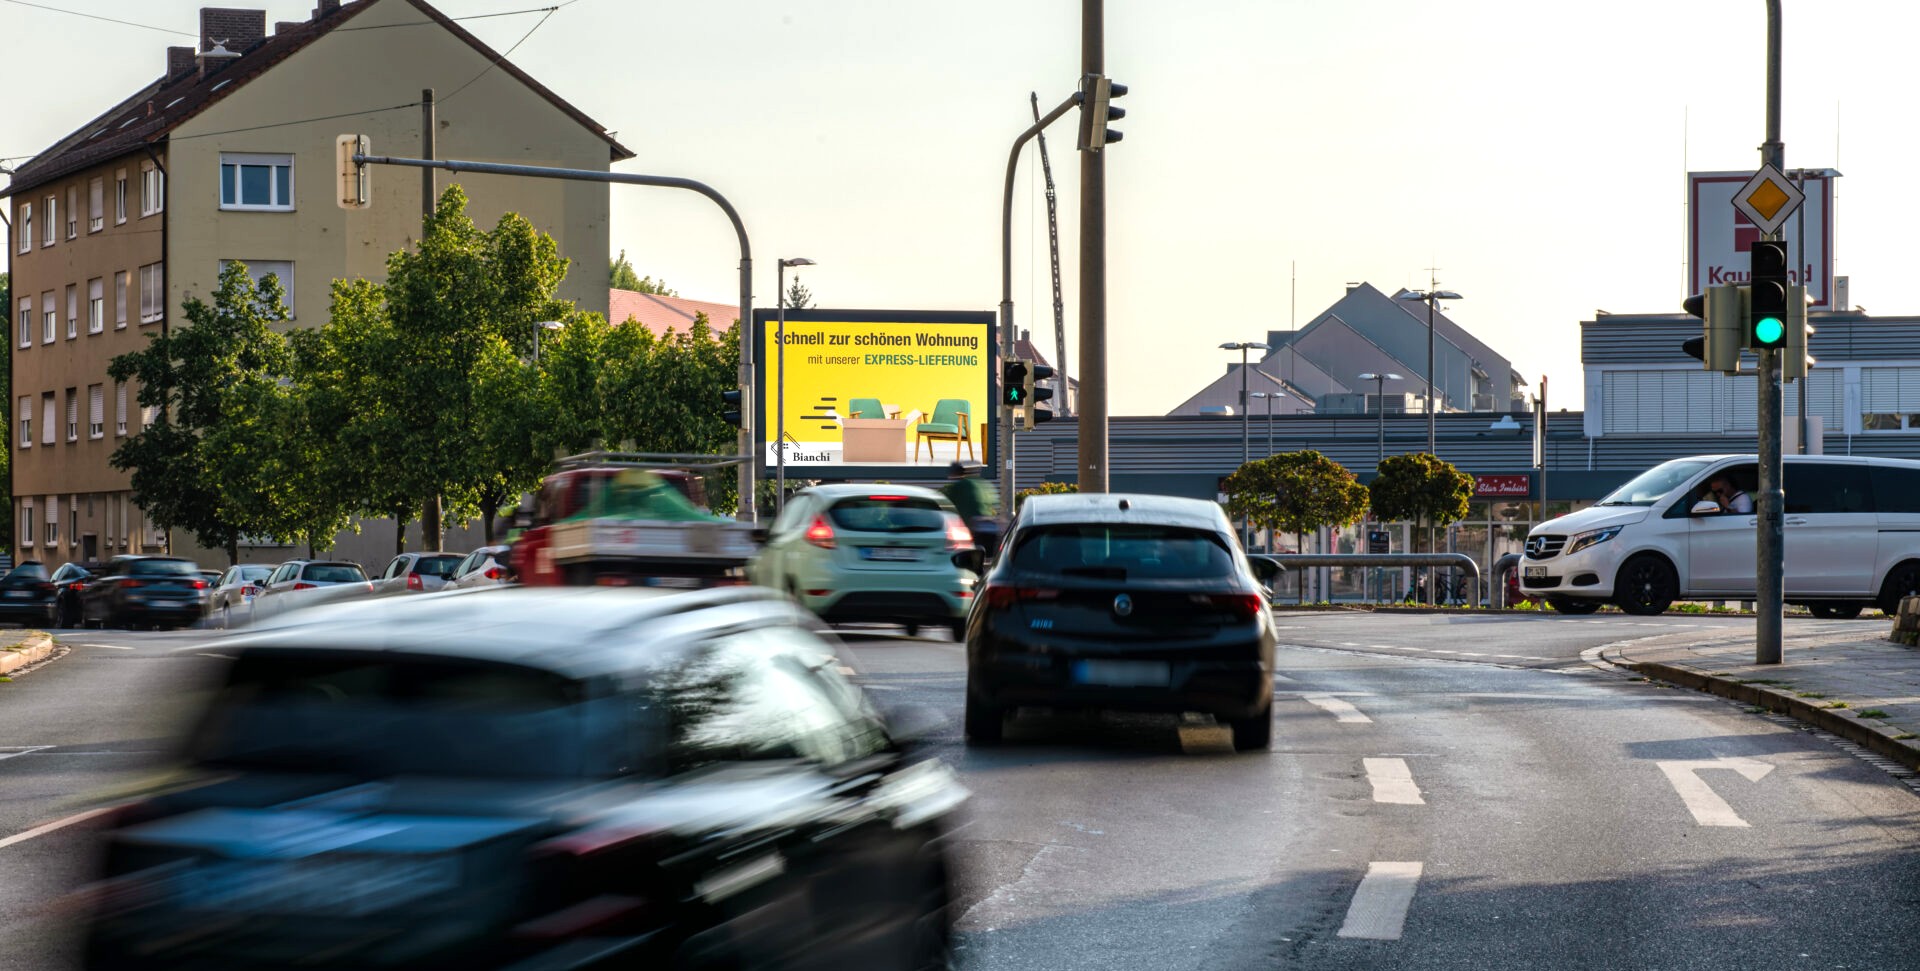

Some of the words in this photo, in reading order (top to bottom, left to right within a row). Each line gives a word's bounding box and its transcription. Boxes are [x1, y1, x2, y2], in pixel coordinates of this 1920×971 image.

[1709, 264, 1812, 284] Kaund
[774, 331, 825, 345] Schnell
[829, 335, 851, 345] zur
[855, 332, 911, 346] schönen
[916, 333, 978, 349] Wohnung
[808, 354, 822, 364] mit
[826, 356, 860, 365] unserer
[865, 354, 978, 366] EXPRESS-LIEFERUNG
[793, 452, 830, 461] Bianchi
